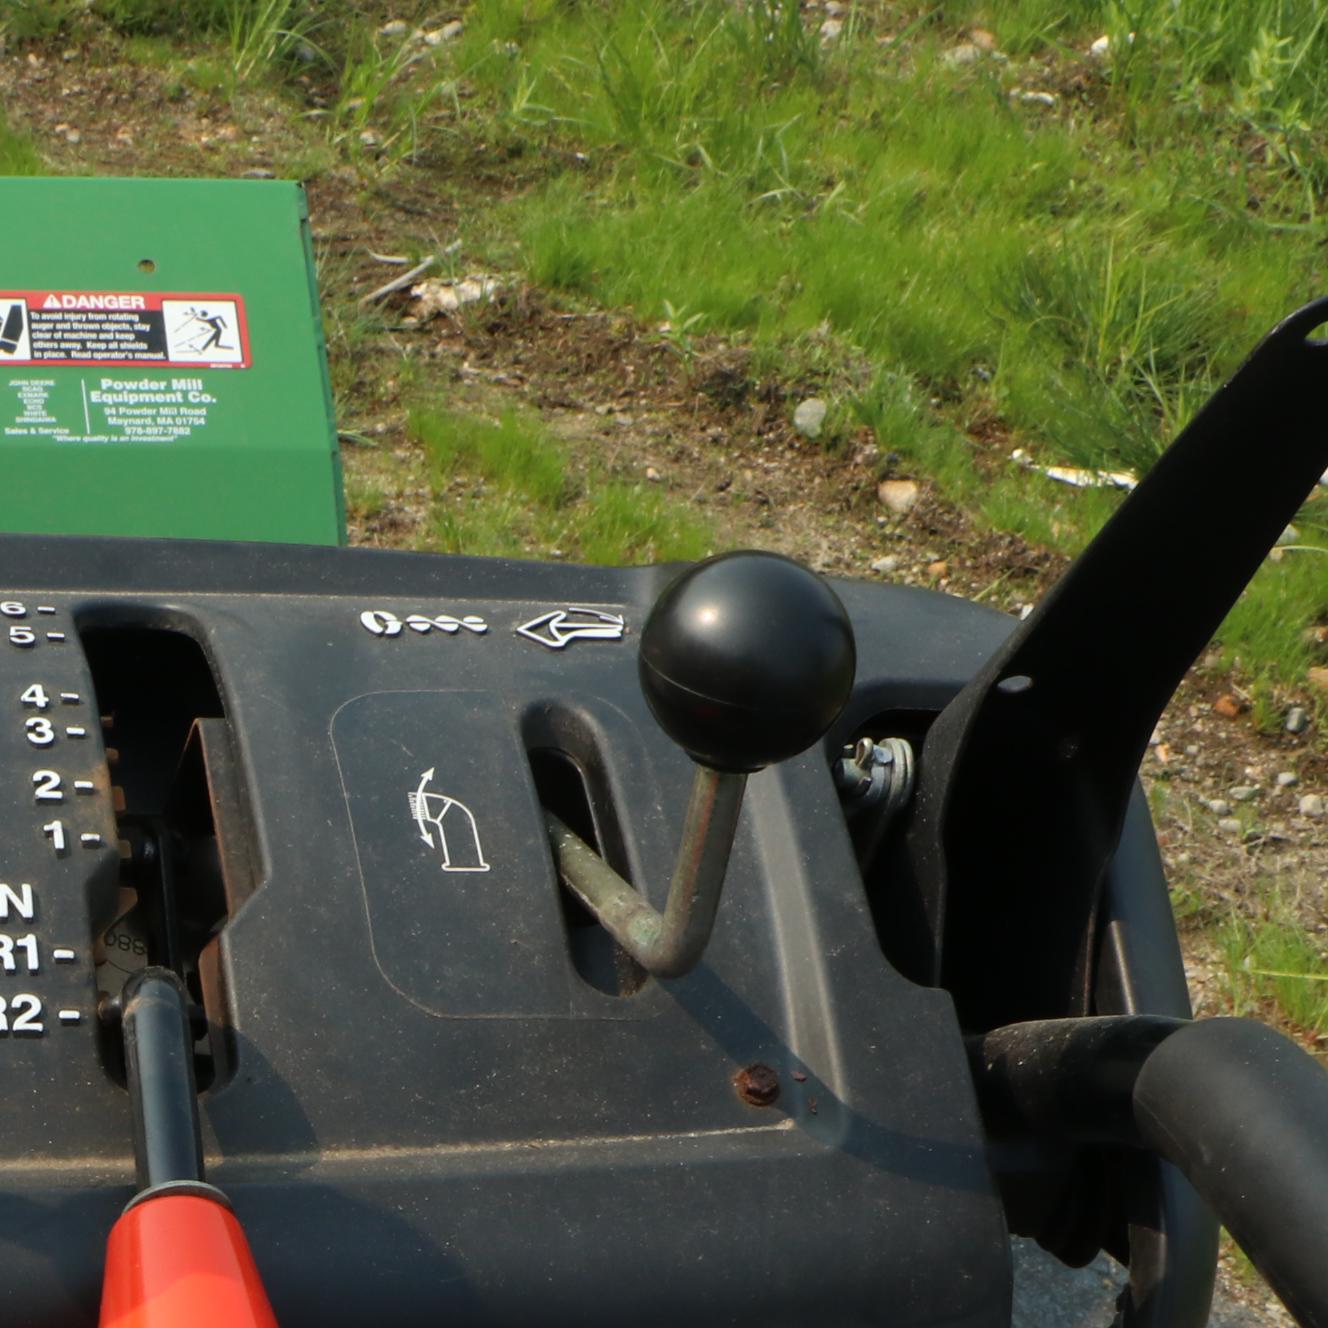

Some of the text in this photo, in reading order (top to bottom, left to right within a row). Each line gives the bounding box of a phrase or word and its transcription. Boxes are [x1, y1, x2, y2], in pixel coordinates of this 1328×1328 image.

[61, 295, 145, 309] DANGER
[30, 312, 139, 322] To avoid injury from rotating
[31, 322, 150, 332] auger and thrown objects, stay
[32, 331, 135, 341] clear of machine and keep
[33, 341, 148, 350] others away. Keep all shields
[34, 350, 166, 360] in place. Read operator's manual.
[100, 379, 203, 390] Powder Mill
[90, 391, 217, 404] Equipment Co.
[119, 407, 156, 416] Powder
[159, 407, 177, 416] Mill
[180, 407, 206, 416] Road
[108, 417, 154, 426] Maynard,
[157, 417, 173, 426] MA
[0, 601, 26, 617] 6
[9, 627, 35, 647] 5
[21, 684, 49, 708] 4
[25, 717, 55, 745] 3
[32, 770, 63, 801] 2
[43, 820, 65, 855] 1
